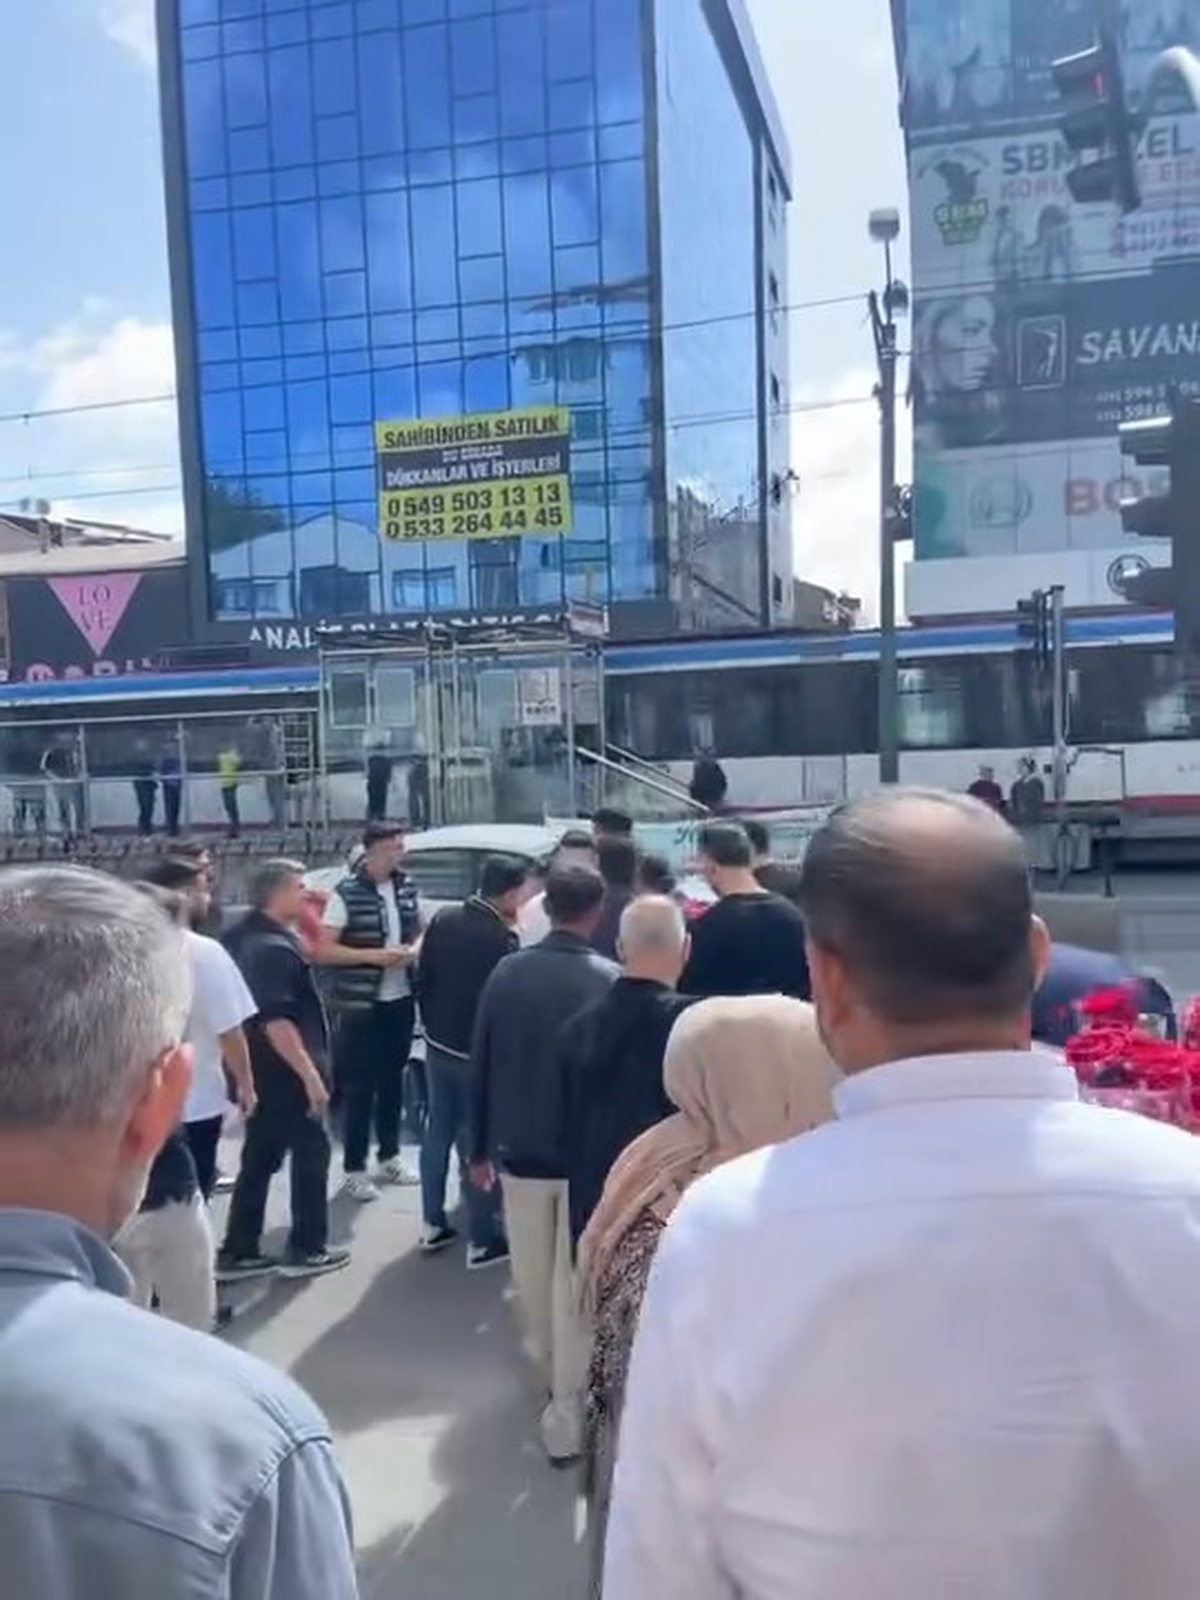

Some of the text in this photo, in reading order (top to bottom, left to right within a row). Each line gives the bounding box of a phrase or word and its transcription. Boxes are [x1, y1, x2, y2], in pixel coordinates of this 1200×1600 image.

[1136, 124, 1194, 159] EL
[1076, 320, 1200, 365] SAVAN
[471, 460, 489, 478] VE
[452, 490, 493, 512] 503
[500, 486, 526, 507] 13
[534, 482, 561, 503] 13
[452, 512, 493, 535] 264
[500, 509, 527, 530] 44
[535, 506, 563, 527] 45
